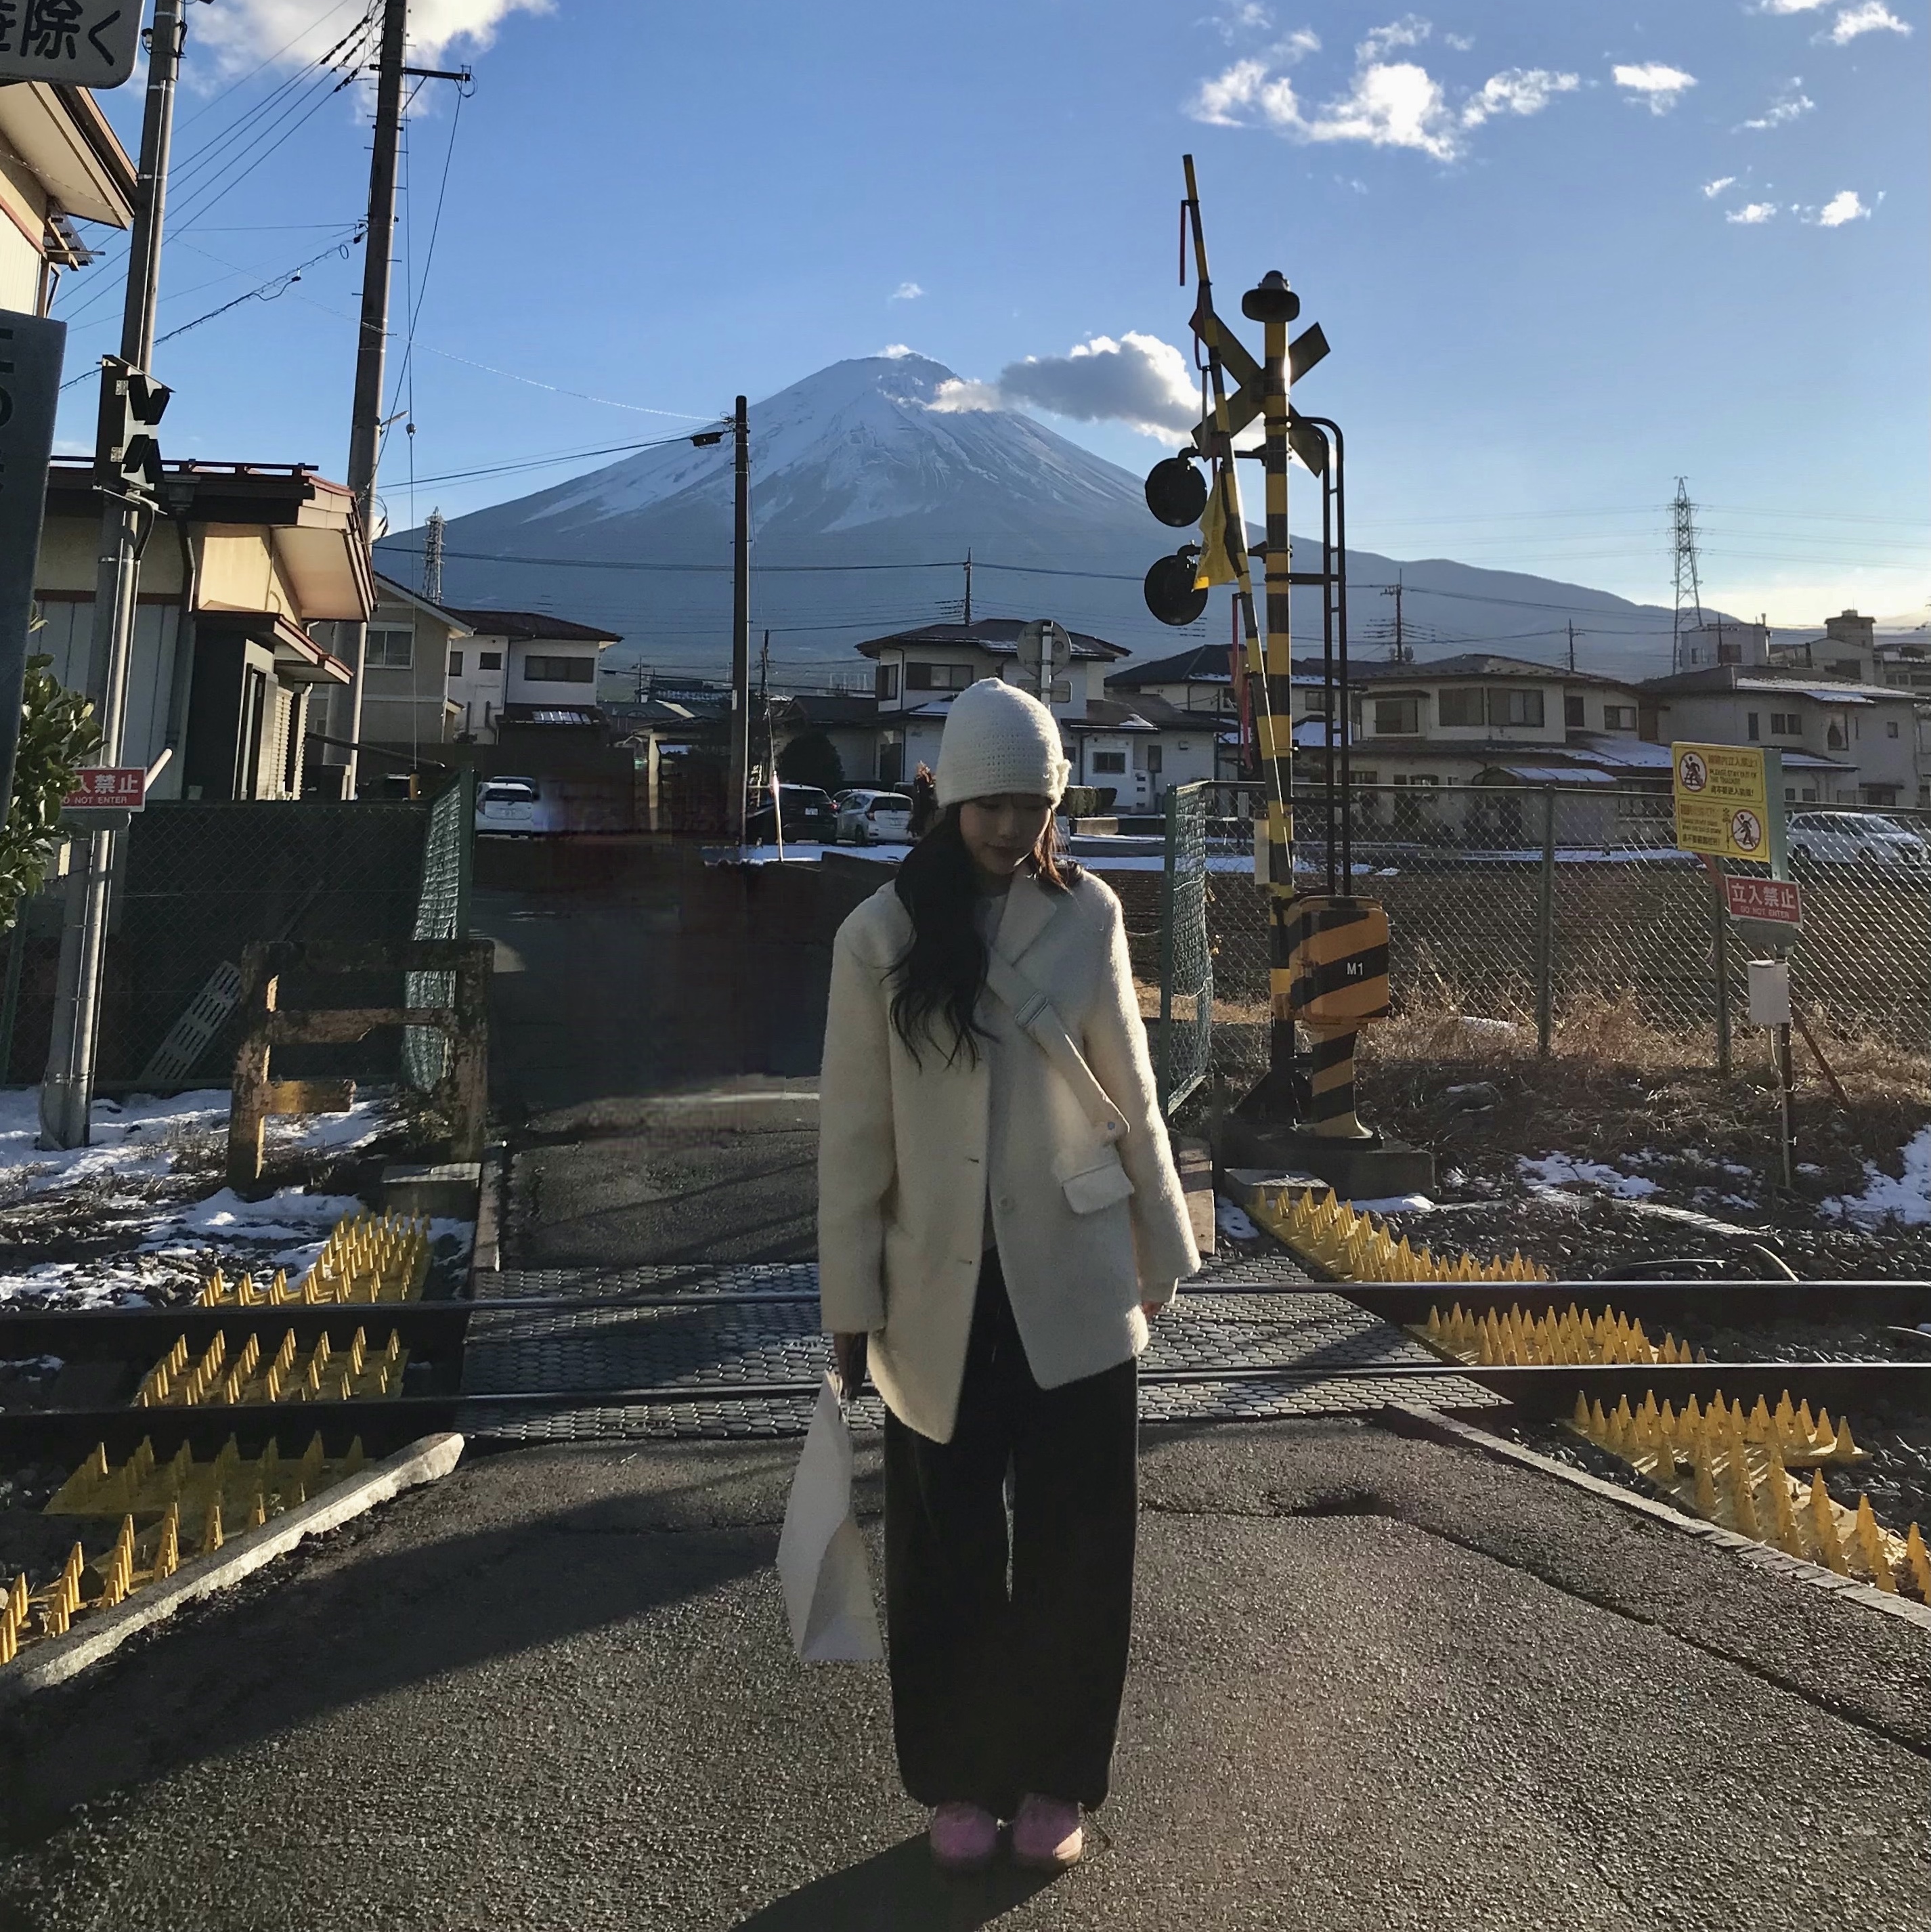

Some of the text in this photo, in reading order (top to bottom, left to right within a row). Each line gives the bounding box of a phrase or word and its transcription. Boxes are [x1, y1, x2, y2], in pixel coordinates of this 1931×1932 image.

[74, 774, 139, 794] 入禁止
[74, 796, 93, 804] NOT
[98, 796, 127, 804] ENTER
[1731, 882, 1796, 909] 立入禁止
[1740, 905, 1789, 920] DO NOT ENTER
[1347, 962, 1363, 975] M1
